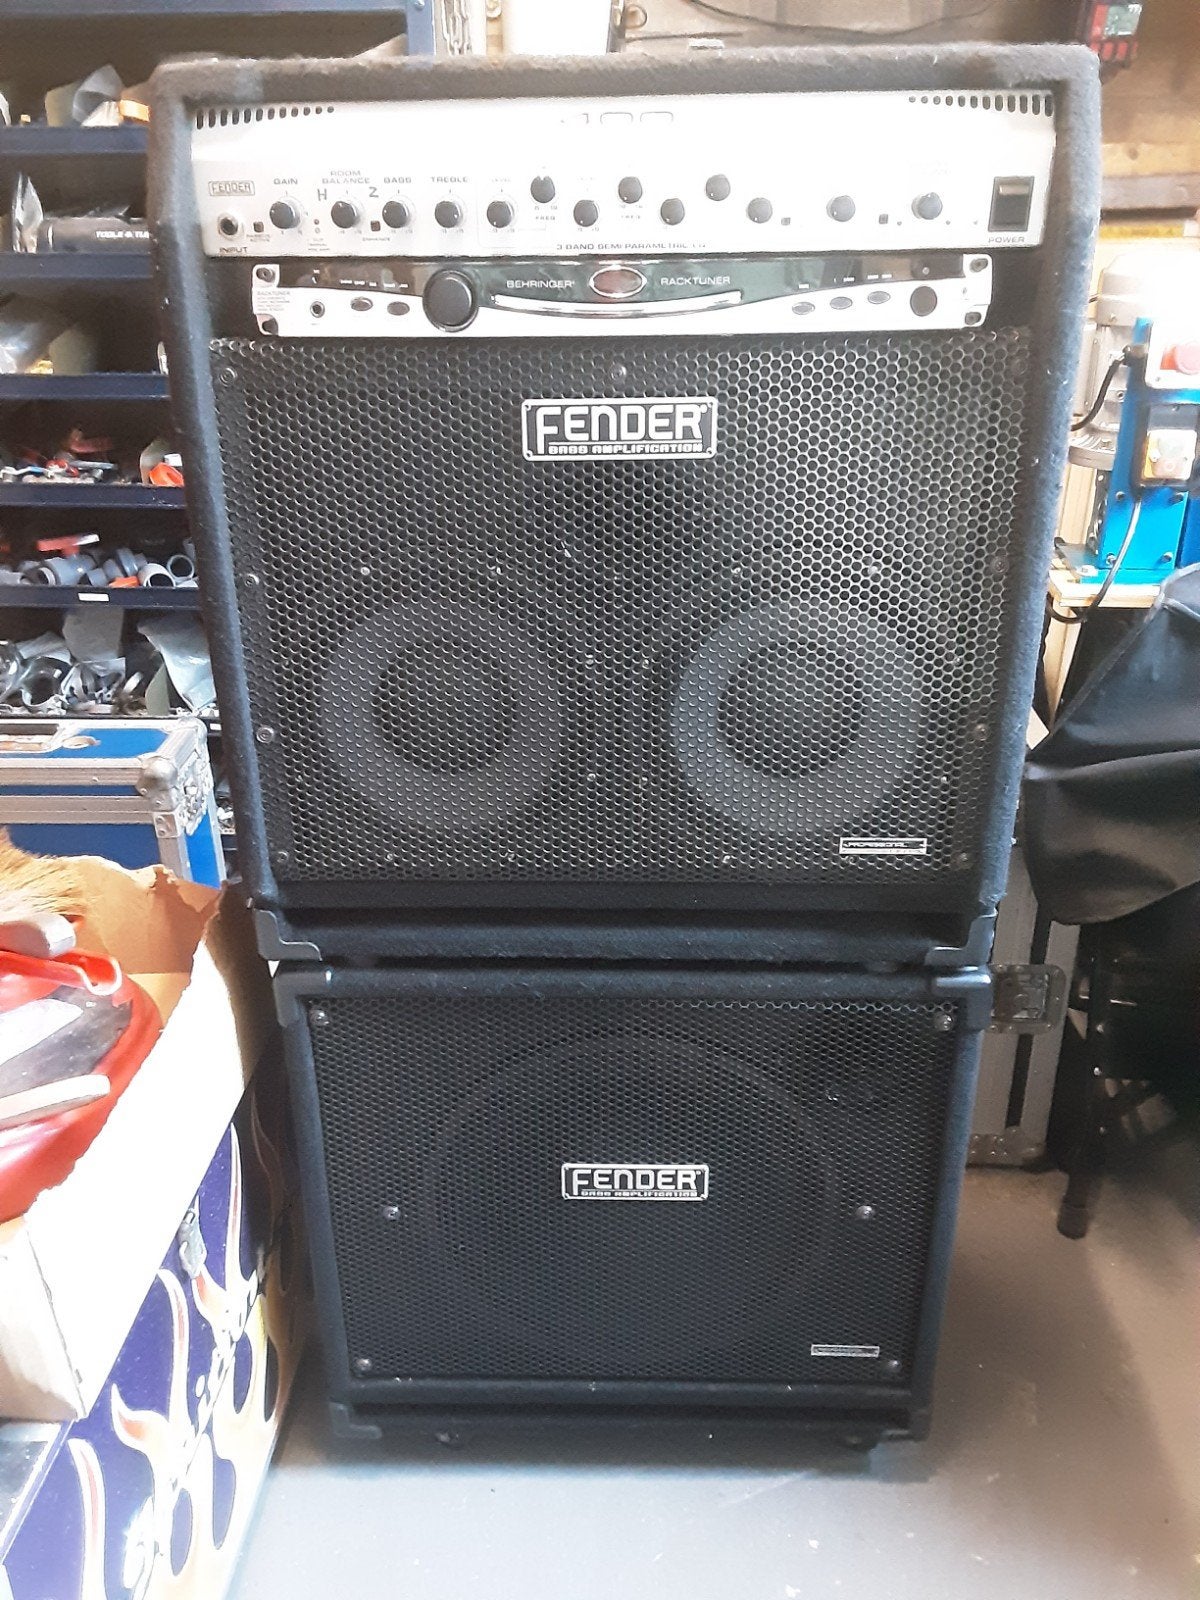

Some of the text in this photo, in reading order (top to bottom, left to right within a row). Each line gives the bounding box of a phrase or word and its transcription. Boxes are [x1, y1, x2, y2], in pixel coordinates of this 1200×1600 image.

[211, 181, 251, 194] FENDER
[988, 236, 1025, 244] POWER
[506, 279, 572, 289] BEHRINGER
[660, 275, 731, 286] RACKTUNER
[536, 404, 703, 454] FENDER
[548, 442, 703, 455] BASS AMPLIFICATION
[572, 1169, 697, 1196] FENDER
